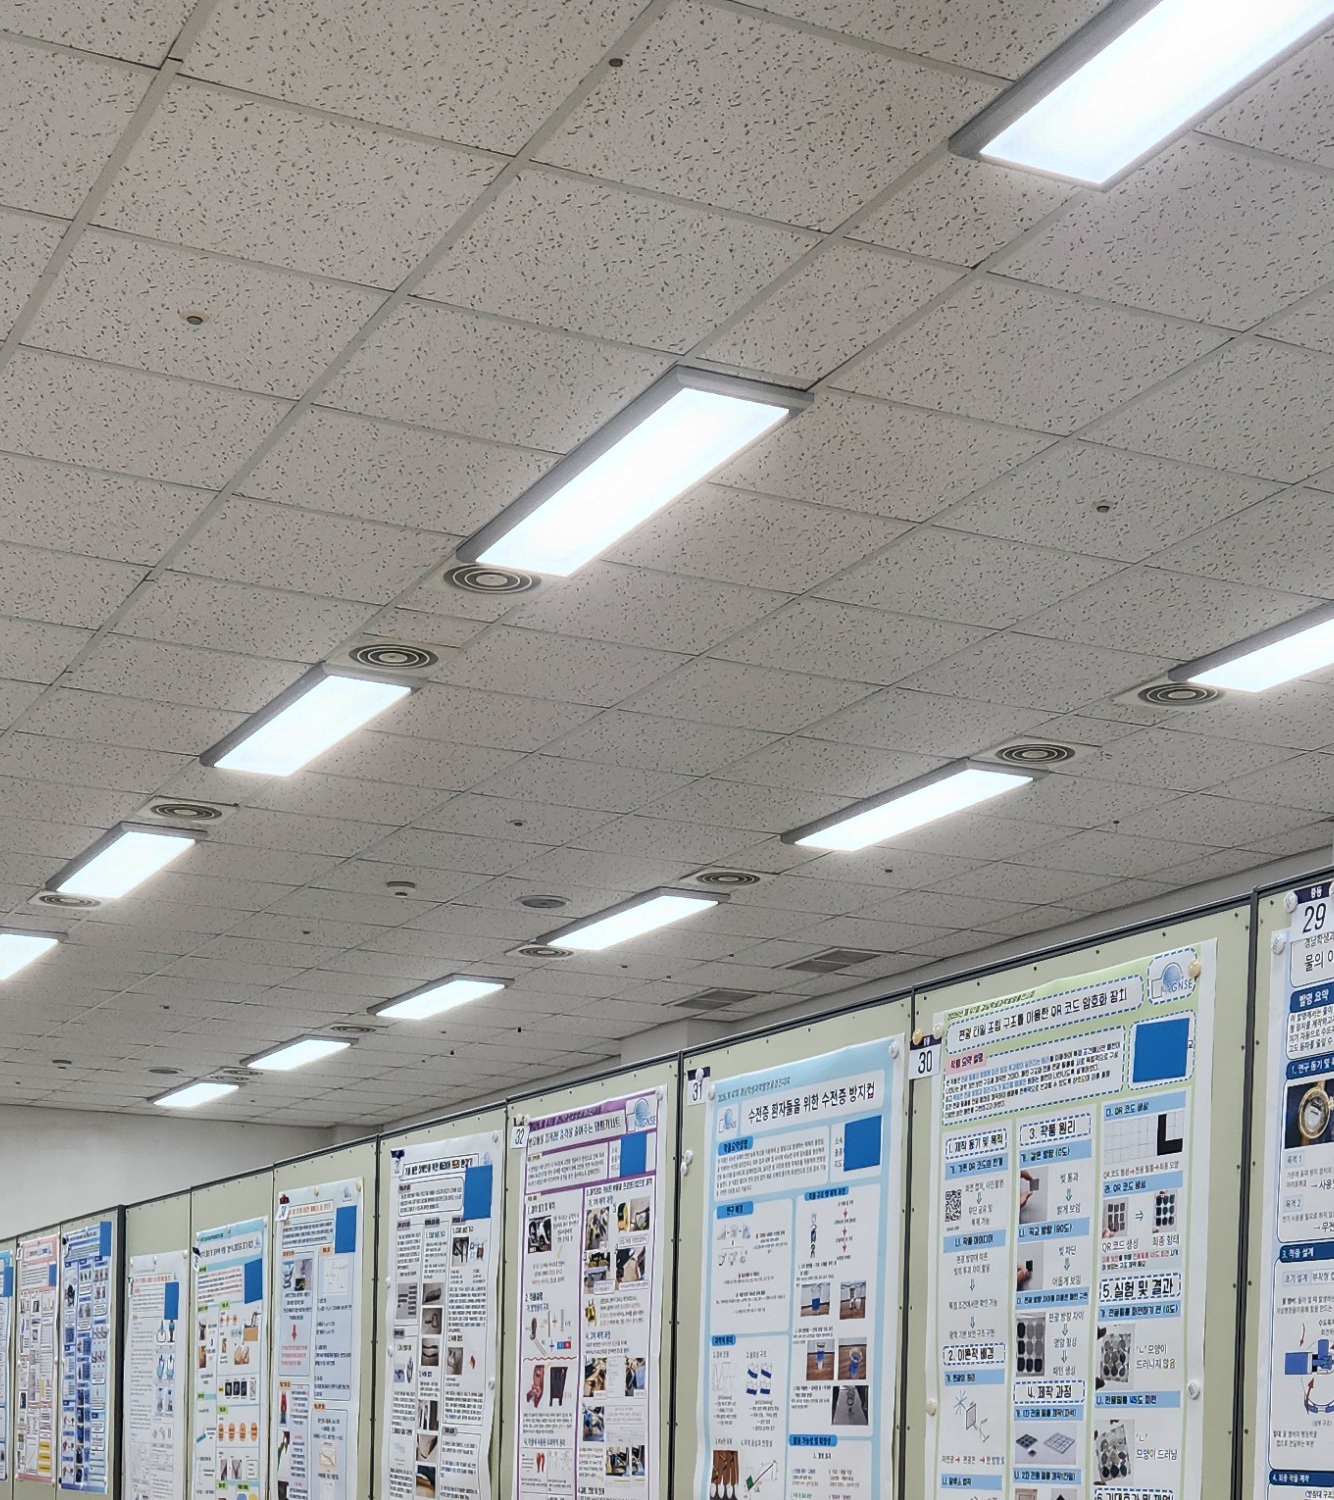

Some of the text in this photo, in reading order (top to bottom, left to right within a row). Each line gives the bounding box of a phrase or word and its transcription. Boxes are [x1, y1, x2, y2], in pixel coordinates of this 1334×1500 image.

[1303, 902, 1326, 933] 29
[1304, 950, 1323, 972] 물의
[917, 1050, 933, 1074] 30
[692, 1082, 703, 1101] 31
[514, 1128, 524, 1145] 32
[1029, 1127, 1037, 1139] 3.
[1102, 1277, 1173, 1300] 5. 실험 및 결과
[1027, 1386, 1035, 1398] 4.
